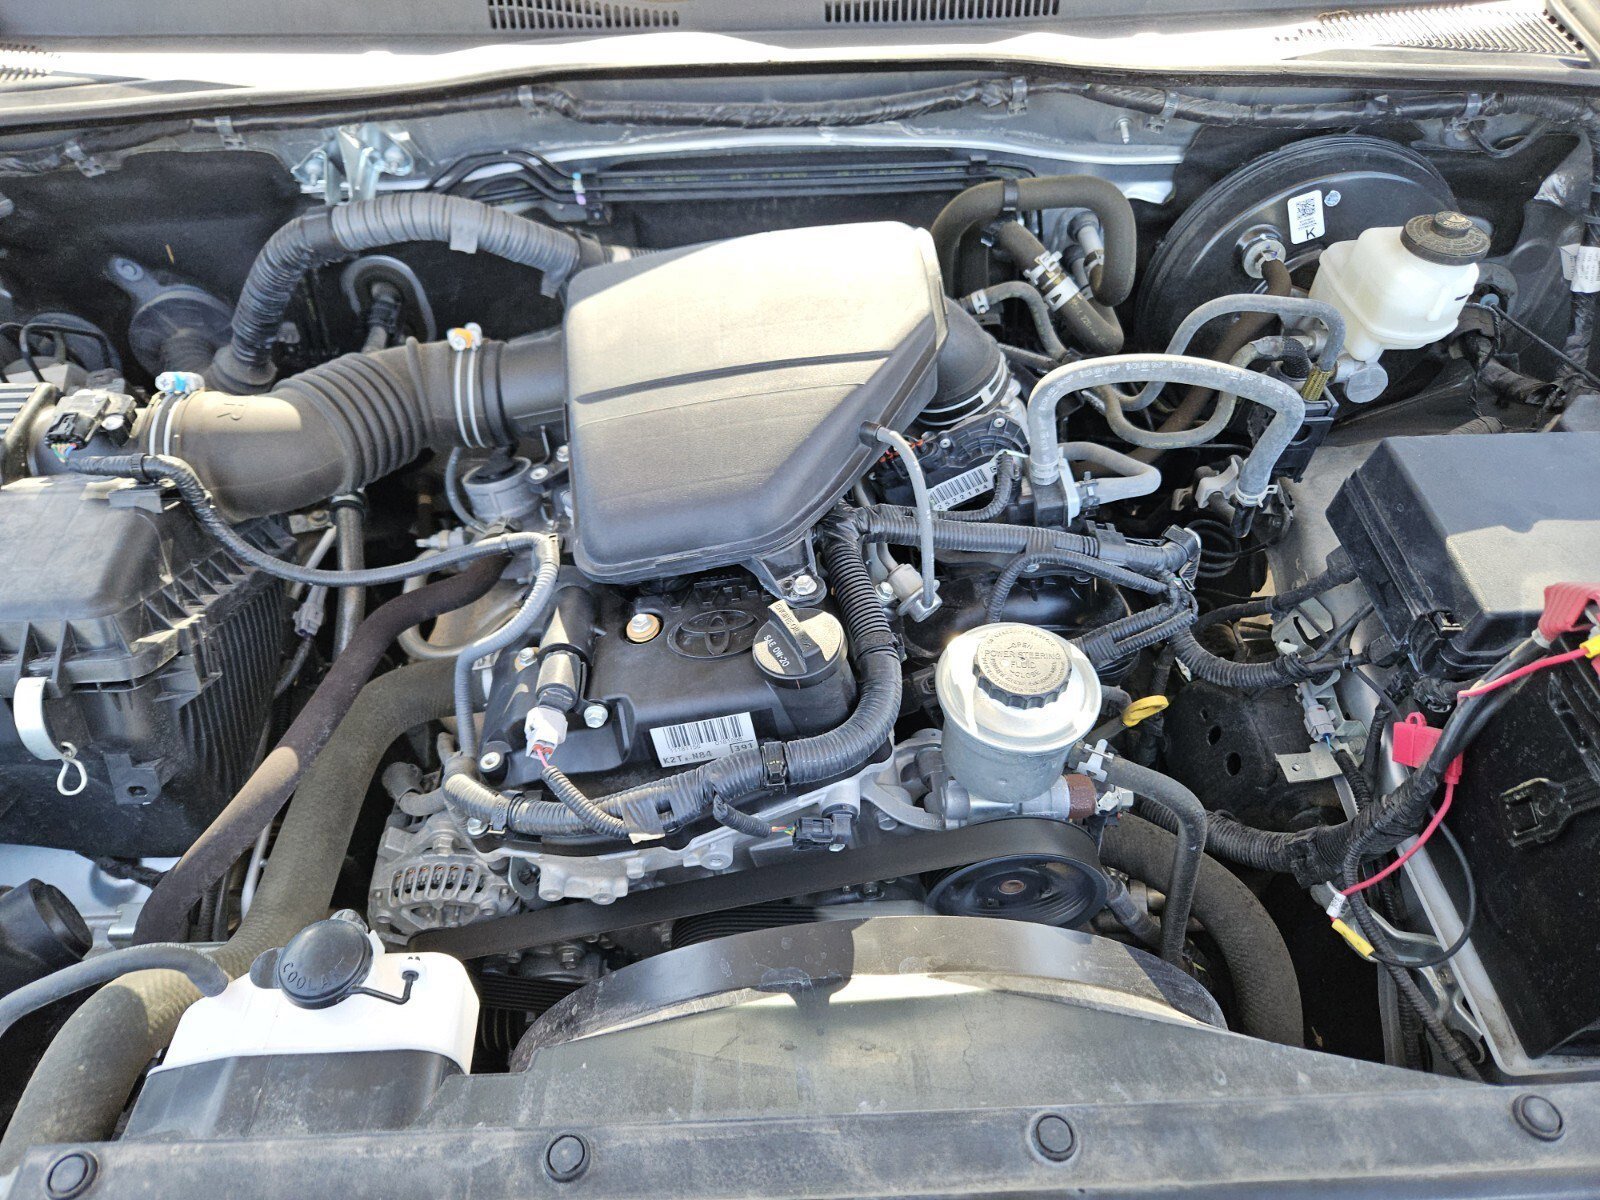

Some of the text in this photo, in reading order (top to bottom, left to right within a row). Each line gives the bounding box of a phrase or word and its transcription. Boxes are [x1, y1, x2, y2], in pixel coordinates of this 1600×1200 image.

[1305, 227, 1316, 240] K
[763, 634, 777, 648] SAE
[984, 649, 1062, 660] POWER STEERING
[1010, 660, 1037, 669] FLUID
